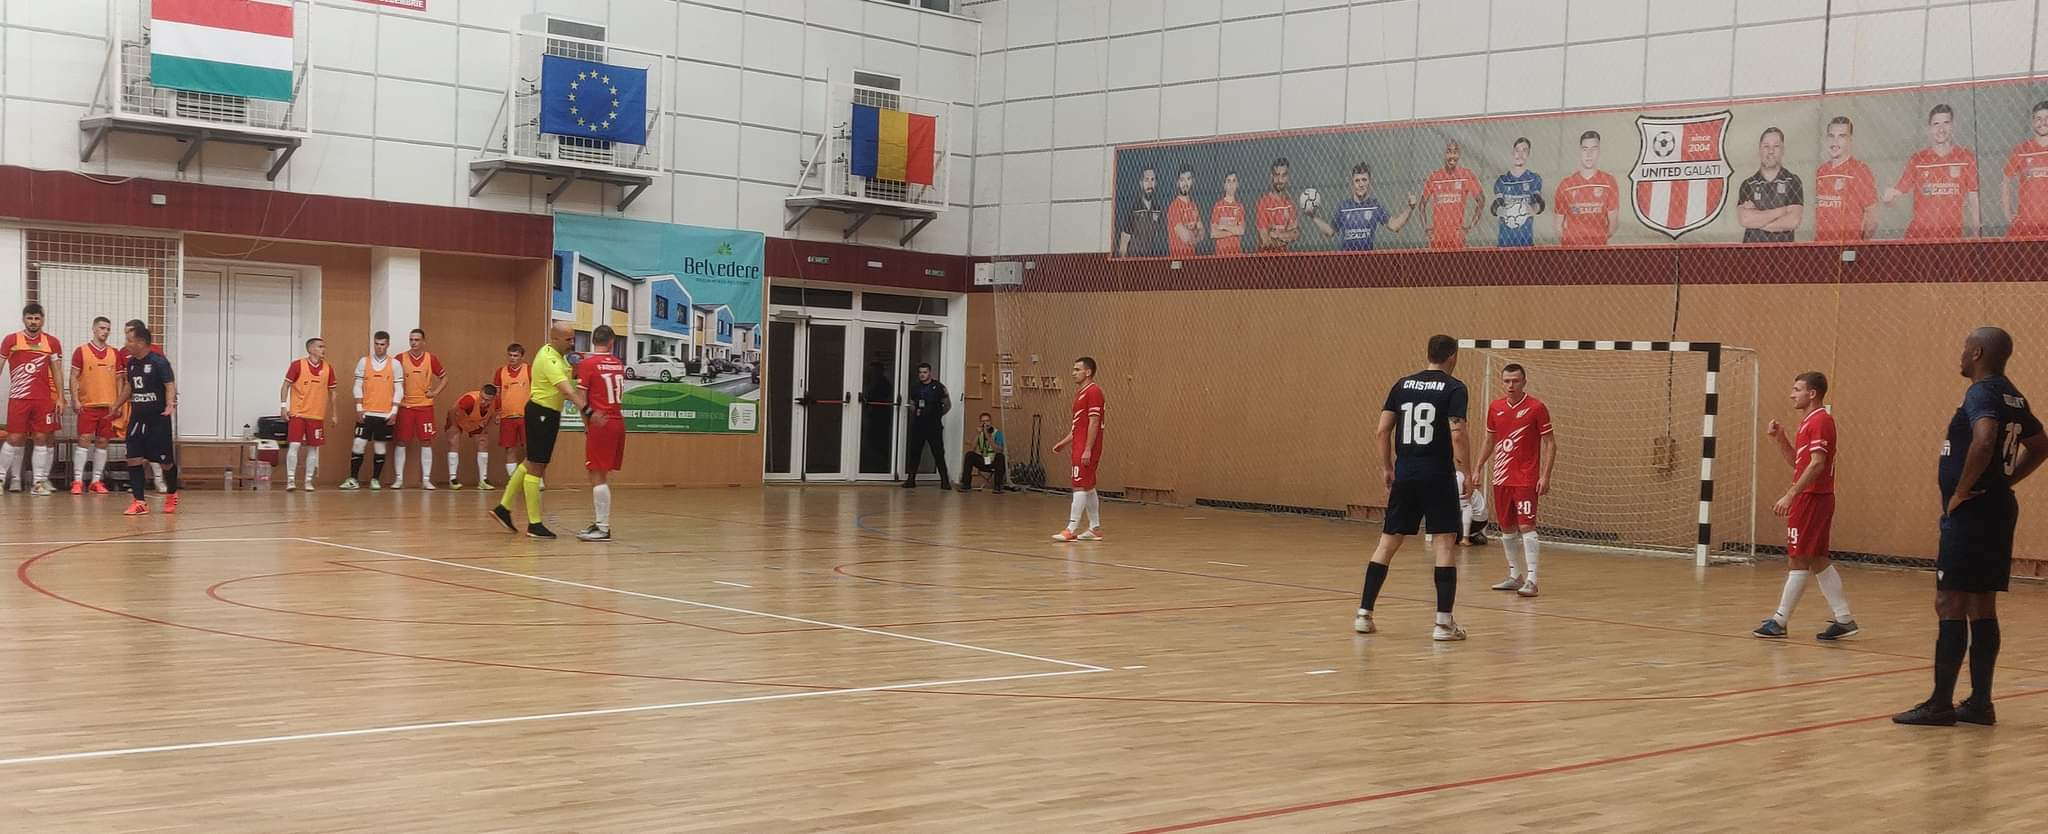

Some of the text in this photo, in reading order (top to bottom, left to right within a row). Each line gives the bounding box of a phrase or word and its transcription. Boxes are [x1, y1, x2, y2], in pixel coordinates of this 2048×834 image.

[1688, 142, 1711, 153] 2004
[1641, 164, 1720, 178] UNITED GALATI
[684, 256, 760, 280] Belvedere
[133, 376, 144, 389] 13
[1403, 380, 1446, 391] CRISTIAN
[1401, 402, 1436, 445] 18
